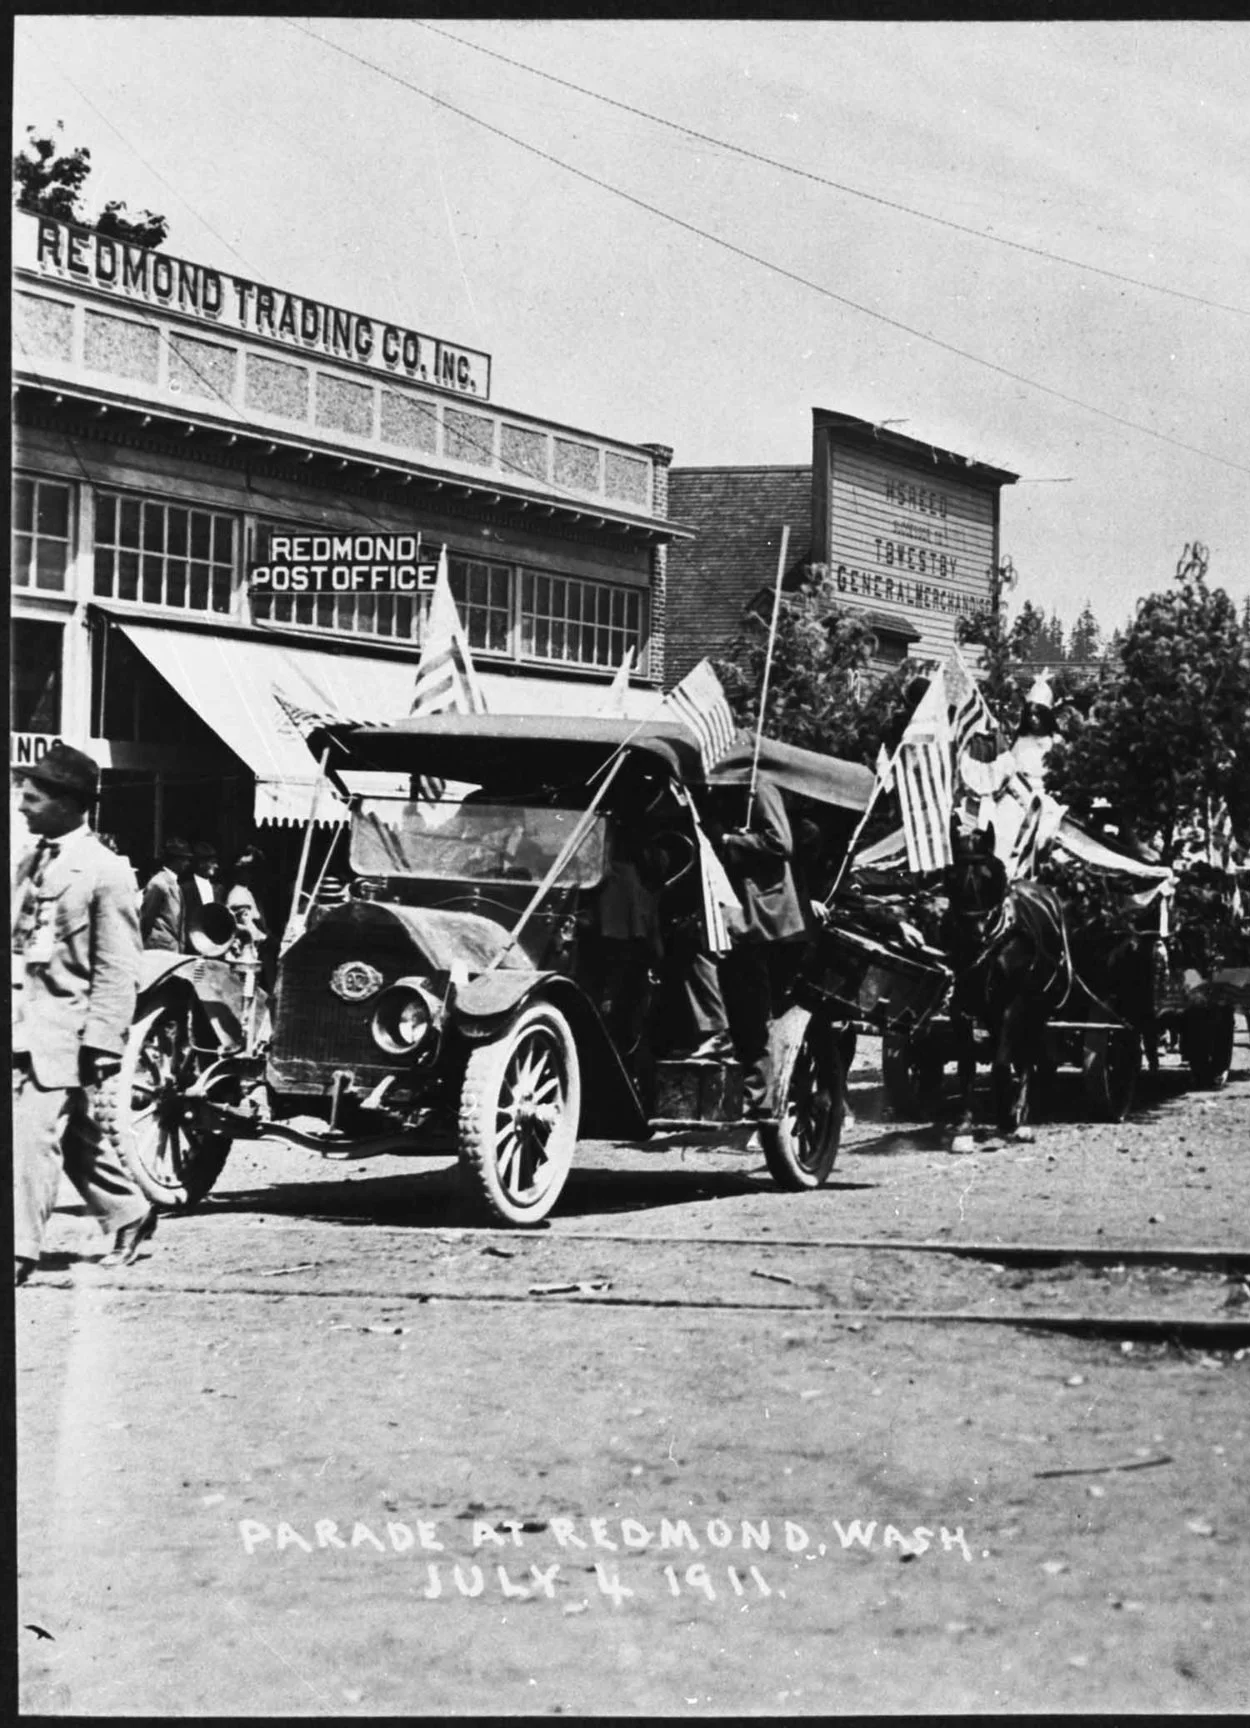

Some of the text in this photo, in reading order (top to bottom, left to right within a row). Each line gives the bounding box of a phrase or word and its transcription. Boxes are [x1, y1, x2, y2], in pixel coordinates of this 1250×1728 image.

[38, 218, 222, 318] REDMOND
[232, 279, 374, 361] TRADING
[272, 536, 416, 561] REDMOND
[252, 566, 437, 590] POST OFFICE
[837, 565, 915, 604] GENERAL
